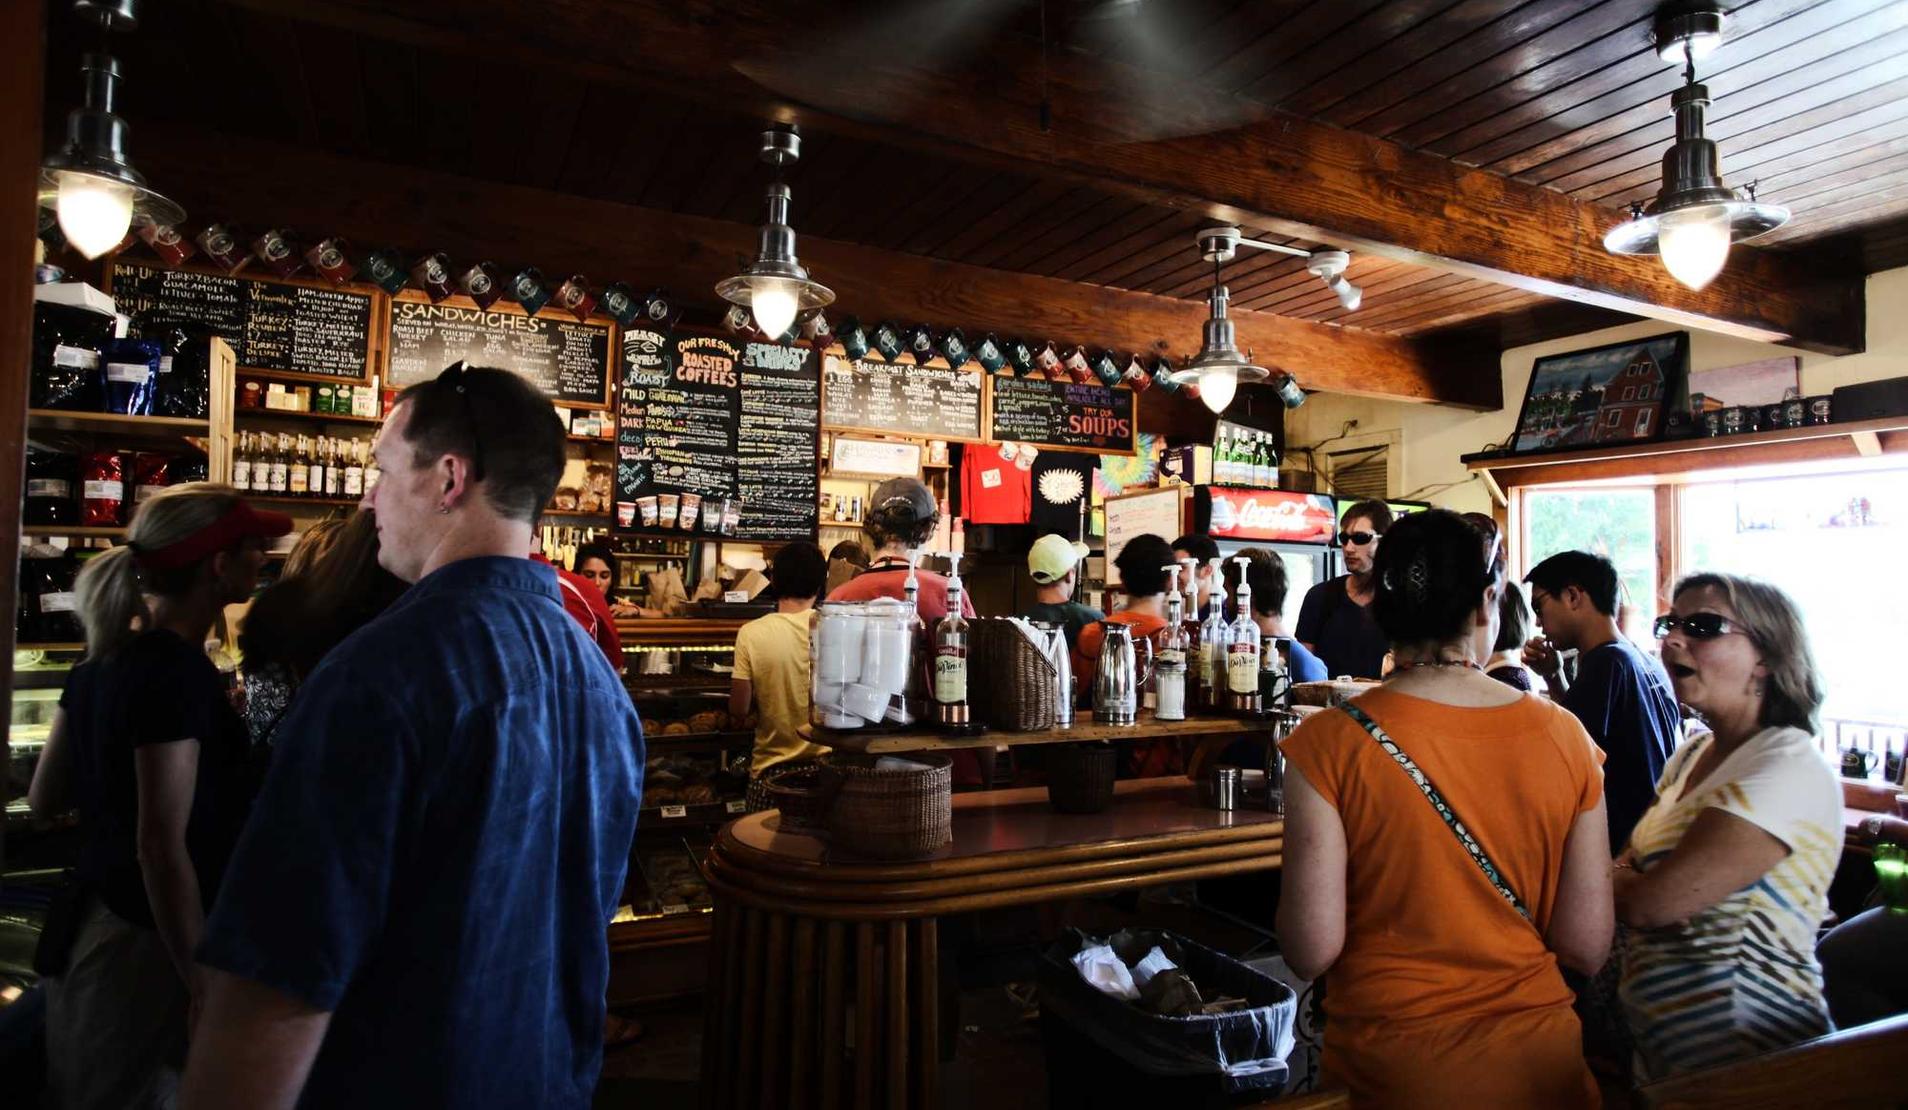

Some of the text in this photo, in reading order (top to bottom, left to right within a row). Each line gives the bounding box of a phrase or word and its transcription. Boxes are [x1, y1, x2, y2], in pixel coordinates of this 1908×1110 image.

[328, 311, 359, 321] WHEAT
[400, 303, 539, 333] SANDWICHES
[393, 324, 434, 336] ROAST BEEF
[440, 329, 476, 338] CHICKEN
[397, 333, 427, 341] TURKEY
[678, 337, 740, 362] OUR FRESHLY
[682, 352, 732, 372] ROASTED
[855, 359, 956, 380] BREAKFAST SANDWICHES
[676, 366, 737, 388] COFFEES
[622, 388, 646, 401] MILD
[1083, 407, 1115, 418] TRY OUR
[620, 416, 673, 428] DARK PAPUA
[1068, 414, 1130, 438] SOUPS
[645, 436, 669, 447] PERU
